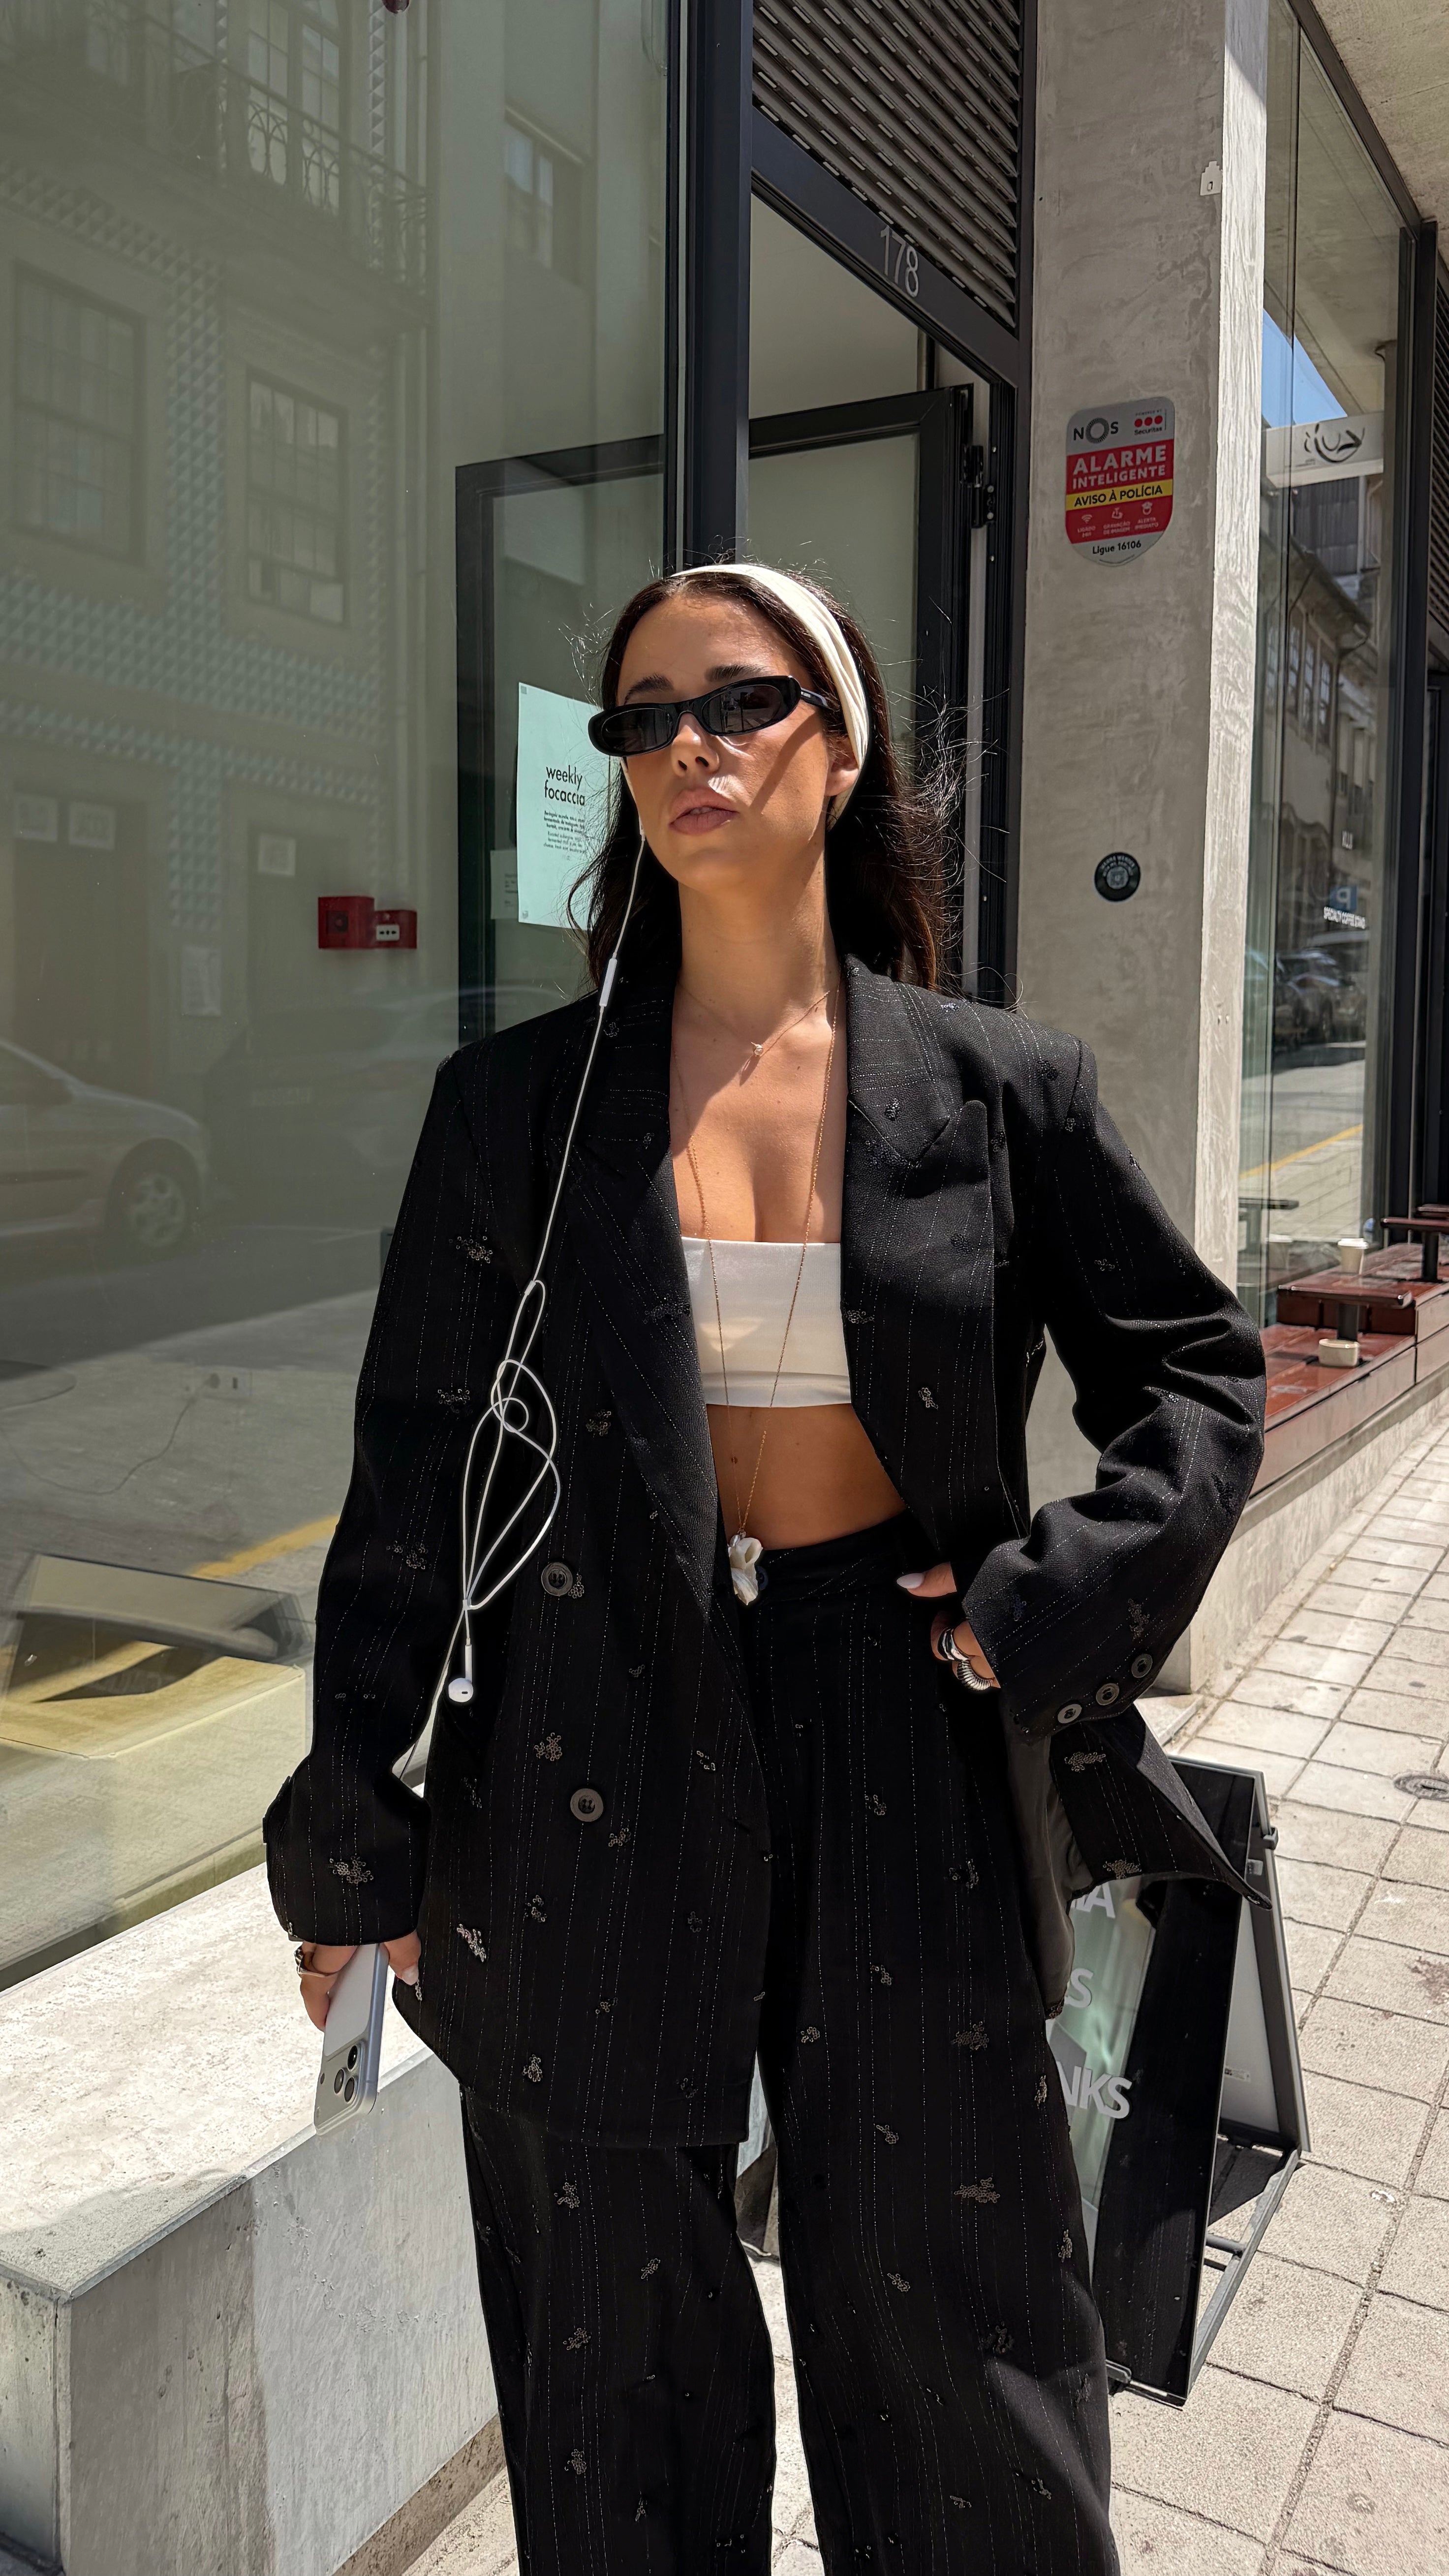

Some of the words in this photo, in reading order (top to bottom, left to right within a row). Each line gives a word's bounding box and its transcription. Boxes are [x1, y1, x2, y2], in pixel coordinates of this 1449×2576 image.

[880, 224, 919, 297] 178
[1073, 417, 1119, 444] NOS
[1134, 427, 1163, 436] Securitas
[1073, 445, 1167, 476] ALARME
[1072, 465, 1166, 490] INTELIGENTE
[1074, 493, 1107, 507] AVISO
[1109, 490, 1117, 502] À
[1119, 485, 1163, 500] POLÍCIA
[1092, 546, 1115, 556] Ligue
[1117, 540, 1141, 551] 16106
[546, 765, 583, 791] weekly
[544, 779, 585, 806] focaccia
